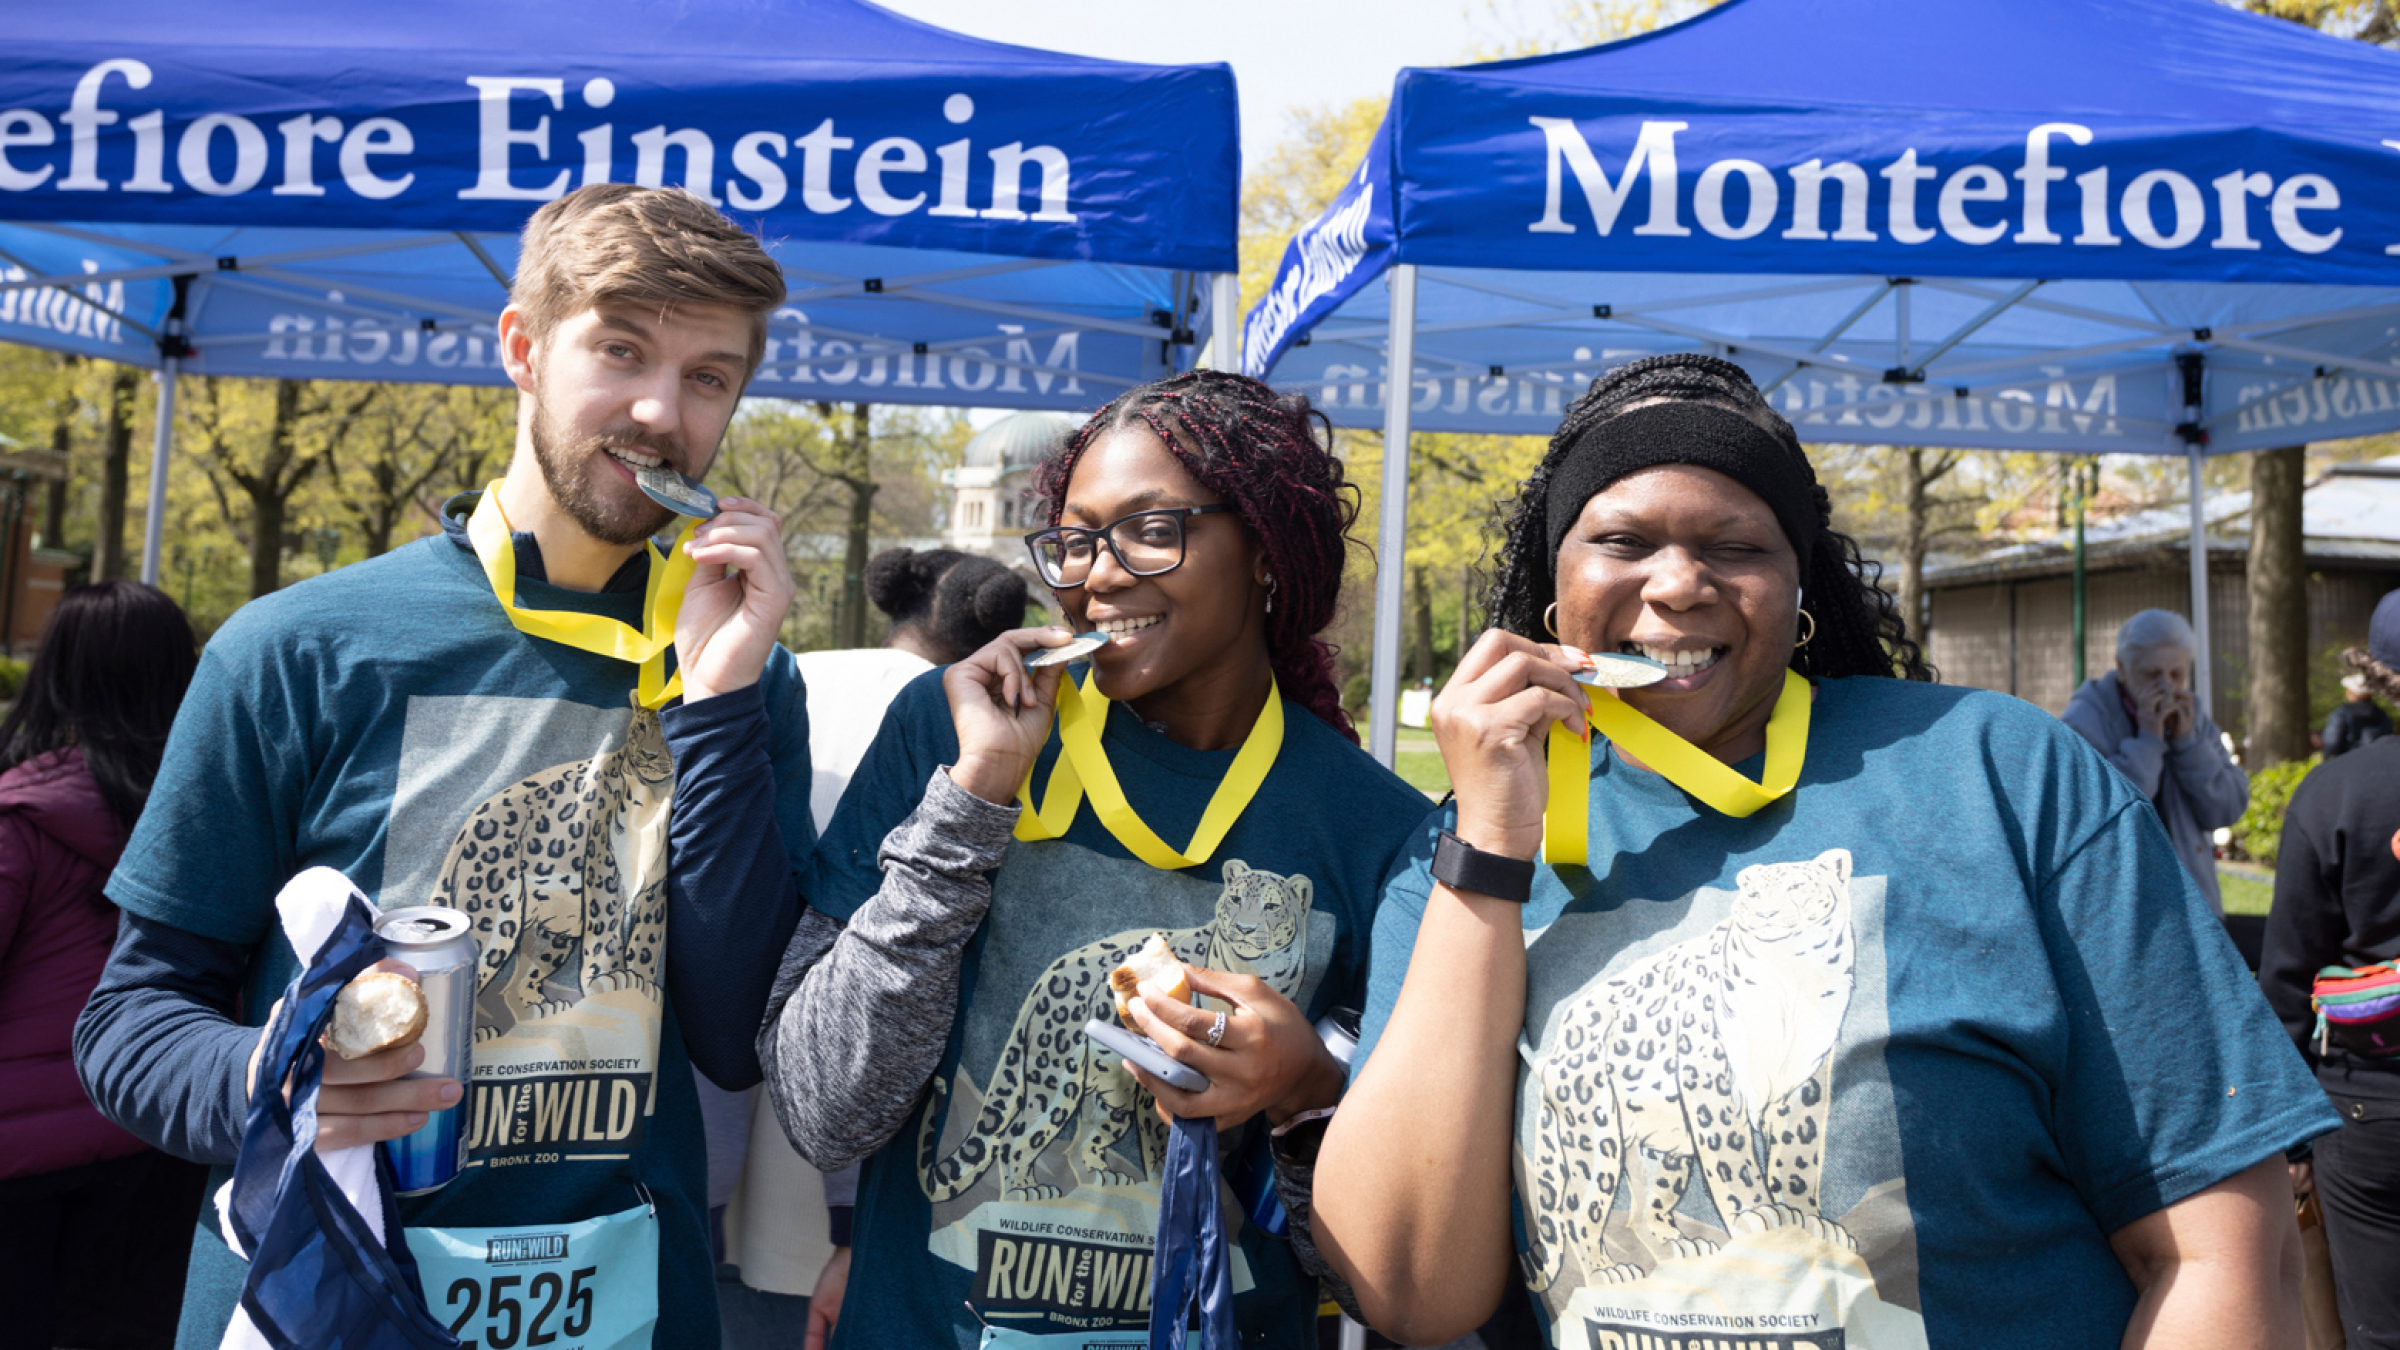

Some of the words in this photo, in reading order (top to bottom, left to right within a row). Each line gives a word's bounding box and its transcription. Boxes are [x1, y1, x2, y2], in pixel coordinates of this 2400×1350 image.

[457, 76, 1078, 223] Einstein
[1530, 118, 2343, 254] Montefiore
[497, 1059, 586, 1076] CONSERVATION
[589, 1058, 641, 1069] SOCIETY
[515, 1083, 533, 1113] the
[533, 1078, 638, 1143] WILD
[512, 1118, 529, 1146] for
[489, 1154, 532, 1169] BRONX
[534, 1152, 560, 1165] ZOO
[999, 1218, 1054, 1235] WILDLIFE
[1056, 1224, 1145, 1245] CONSERVATION
[527, 1236, 564, 1259] WILD
[986, 1237, 1077, 1306] RUN
[1075, 1248, 1094, 1279] the
[446, 1265, 598, 1350] 2525
[1069, 1282, 1087, 1308] for
[1049, 1310, 1090, 1328] BRONX
[1091, 1316, 1115, 1328] ZOO
[1594, 1305, 1651, 1323] WILDLIFE
[1653, 1311, 1755, 1329] CONSERVATION
[1758, 1313, 1820, 1328] SOCIETY
